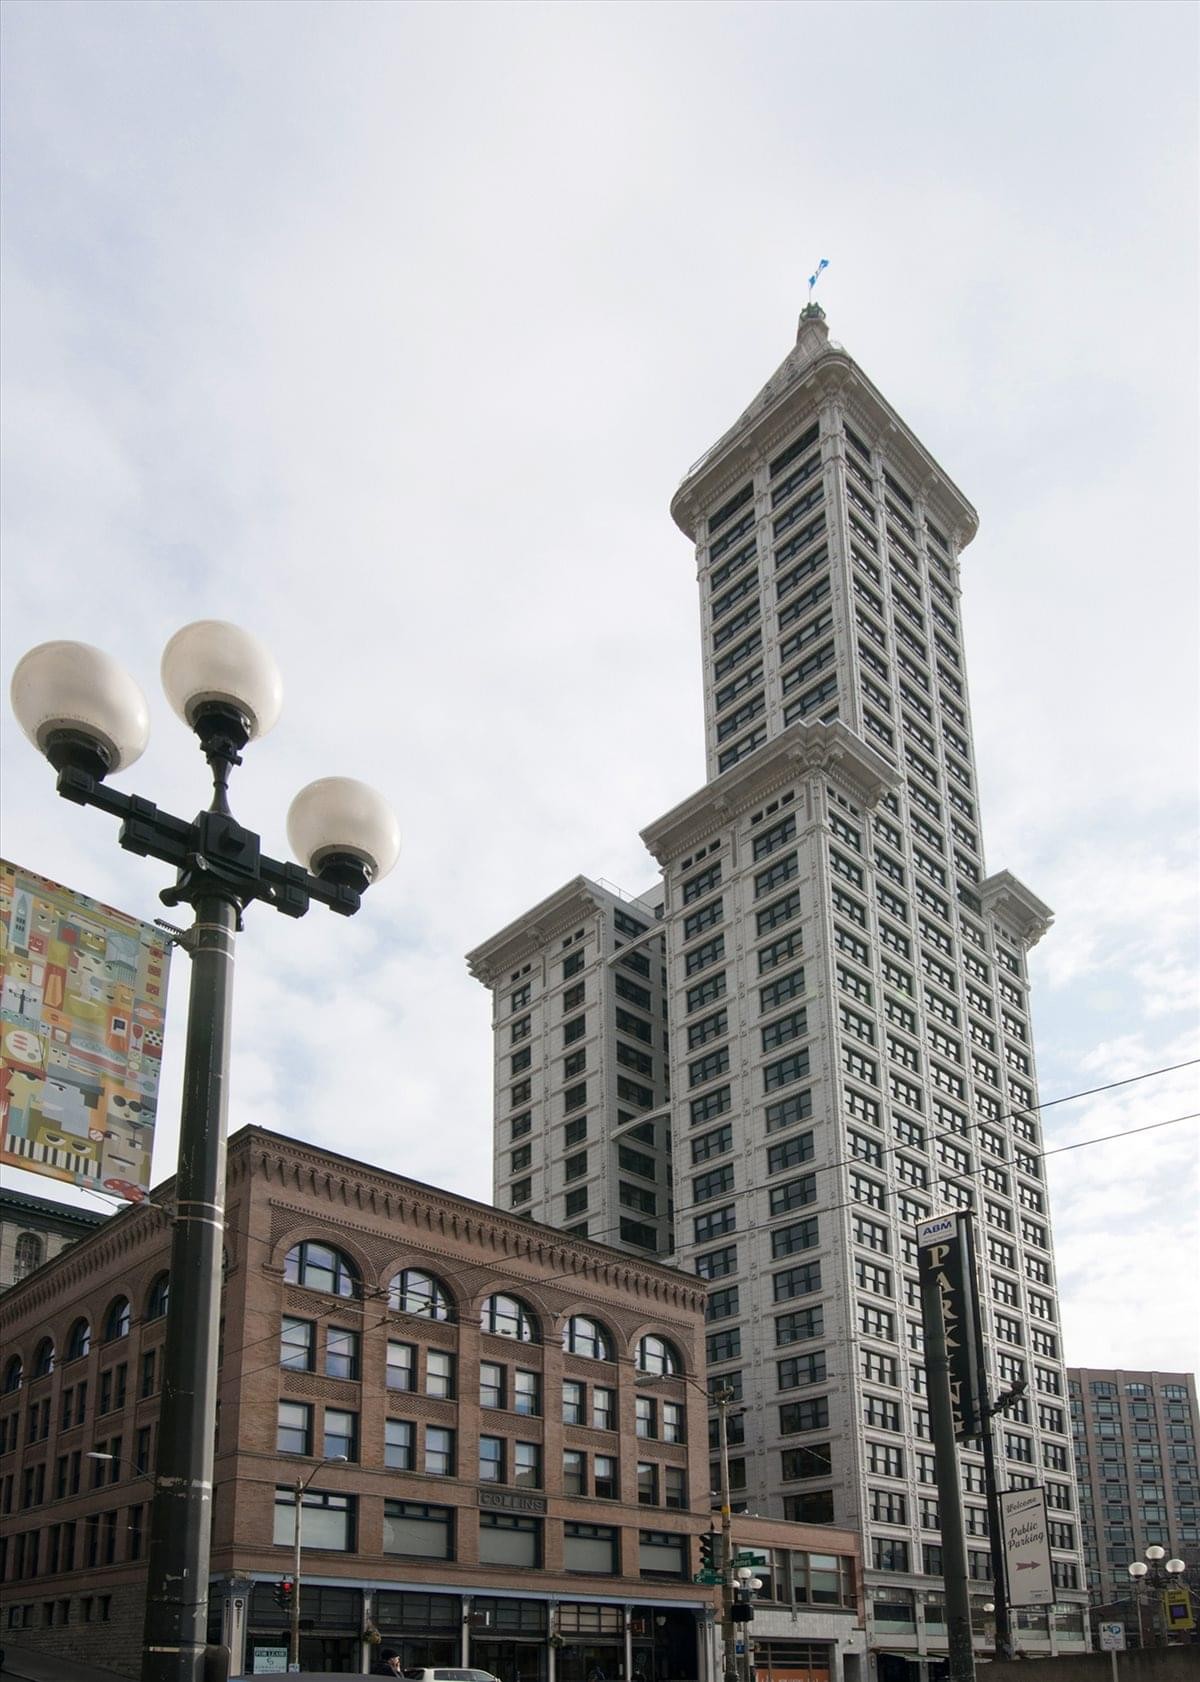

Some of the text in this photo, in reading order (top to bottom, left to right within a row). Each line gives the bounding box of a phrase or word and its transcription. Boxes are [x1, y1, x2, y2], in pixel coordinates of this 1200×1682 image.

[923, 1221, 952, 1236] ABM
[927, 1244, 965, 1433] PARKNG
[481, 1493, 545, 1511] COLLINS
[1006, 1497, 1036, 1513] Welcome
[1009, 1522, 1038, 1539] Public
[1007, 1531, 1044, 1551] Parking
